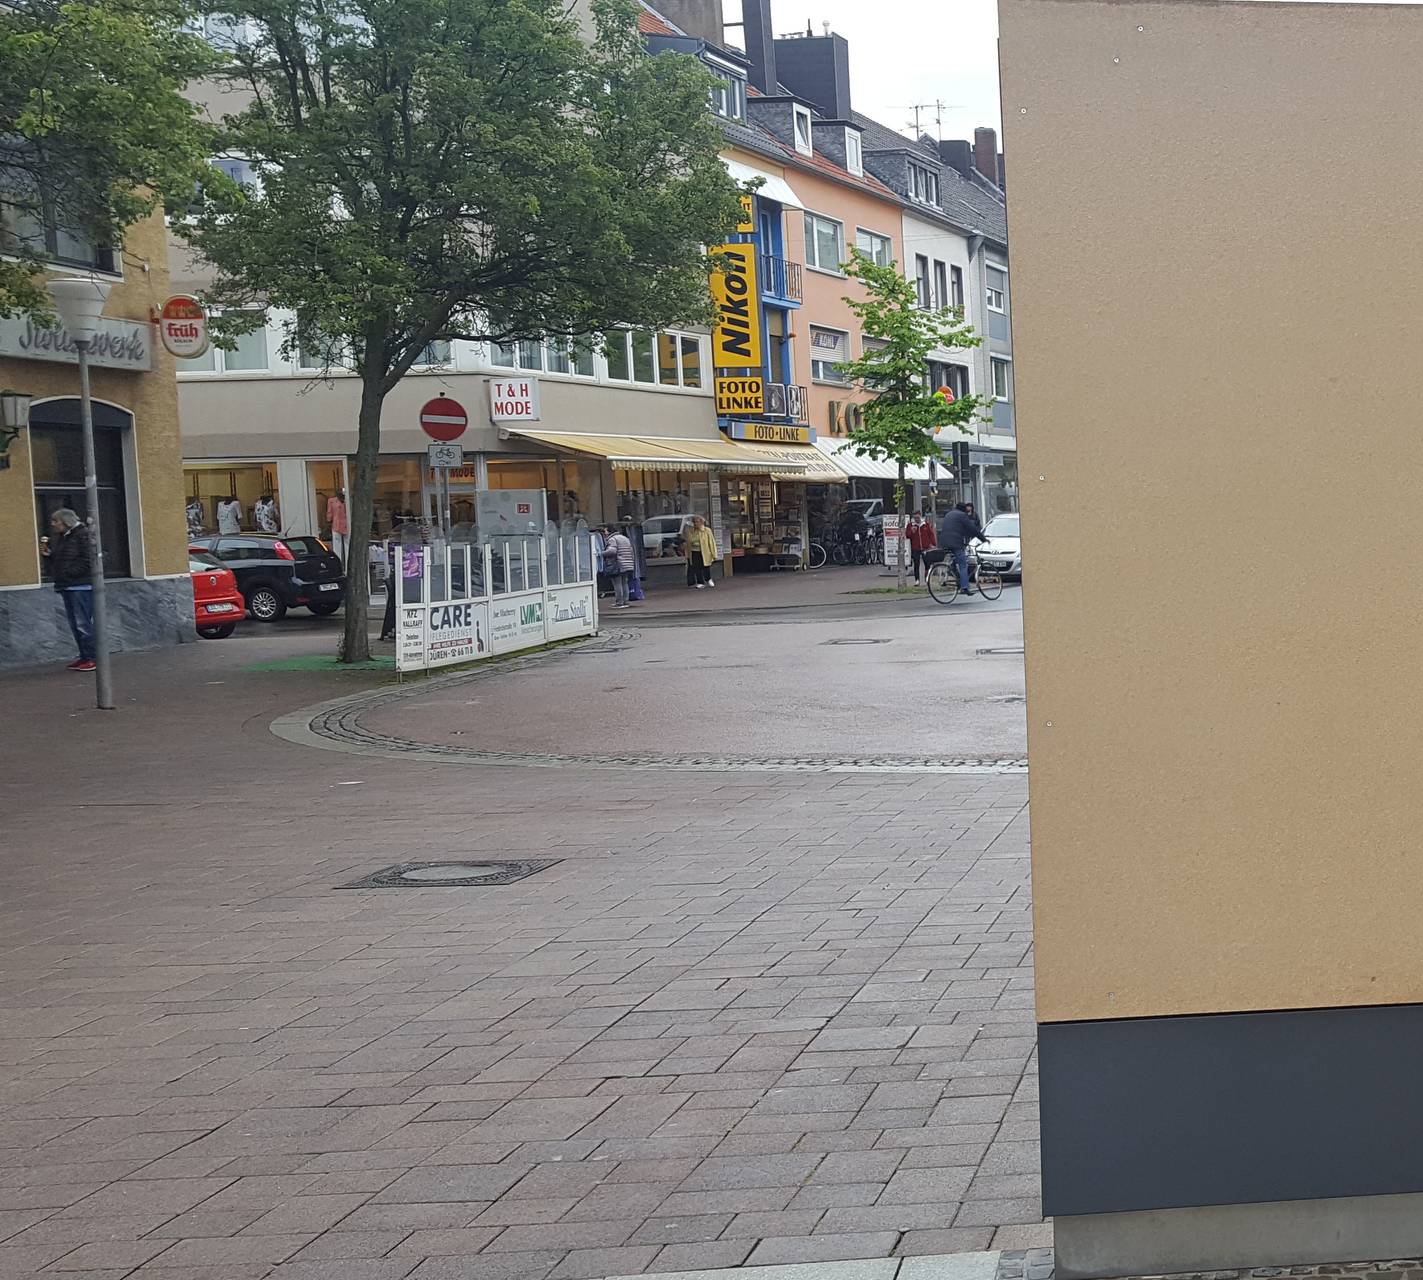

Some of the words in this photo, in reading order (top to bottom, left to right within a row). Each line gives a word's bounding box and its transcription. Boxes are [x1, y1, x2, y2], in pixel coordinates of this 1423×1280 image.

[720, 250, 752, 358] Nikon
[495, 383, 503, 397] T
[507, 383, 516, 398] &
[520, 383, 528, 398] H
[719, 381, 760, 394] FOTO
[494, 401, 531, 416] MODE
[719, 396, 762, 410] LINKE
[754, 425, 775, 439] FOTO
[779, 428, 800, 441] LINKE
[430, 603, 472, 631] CARE
